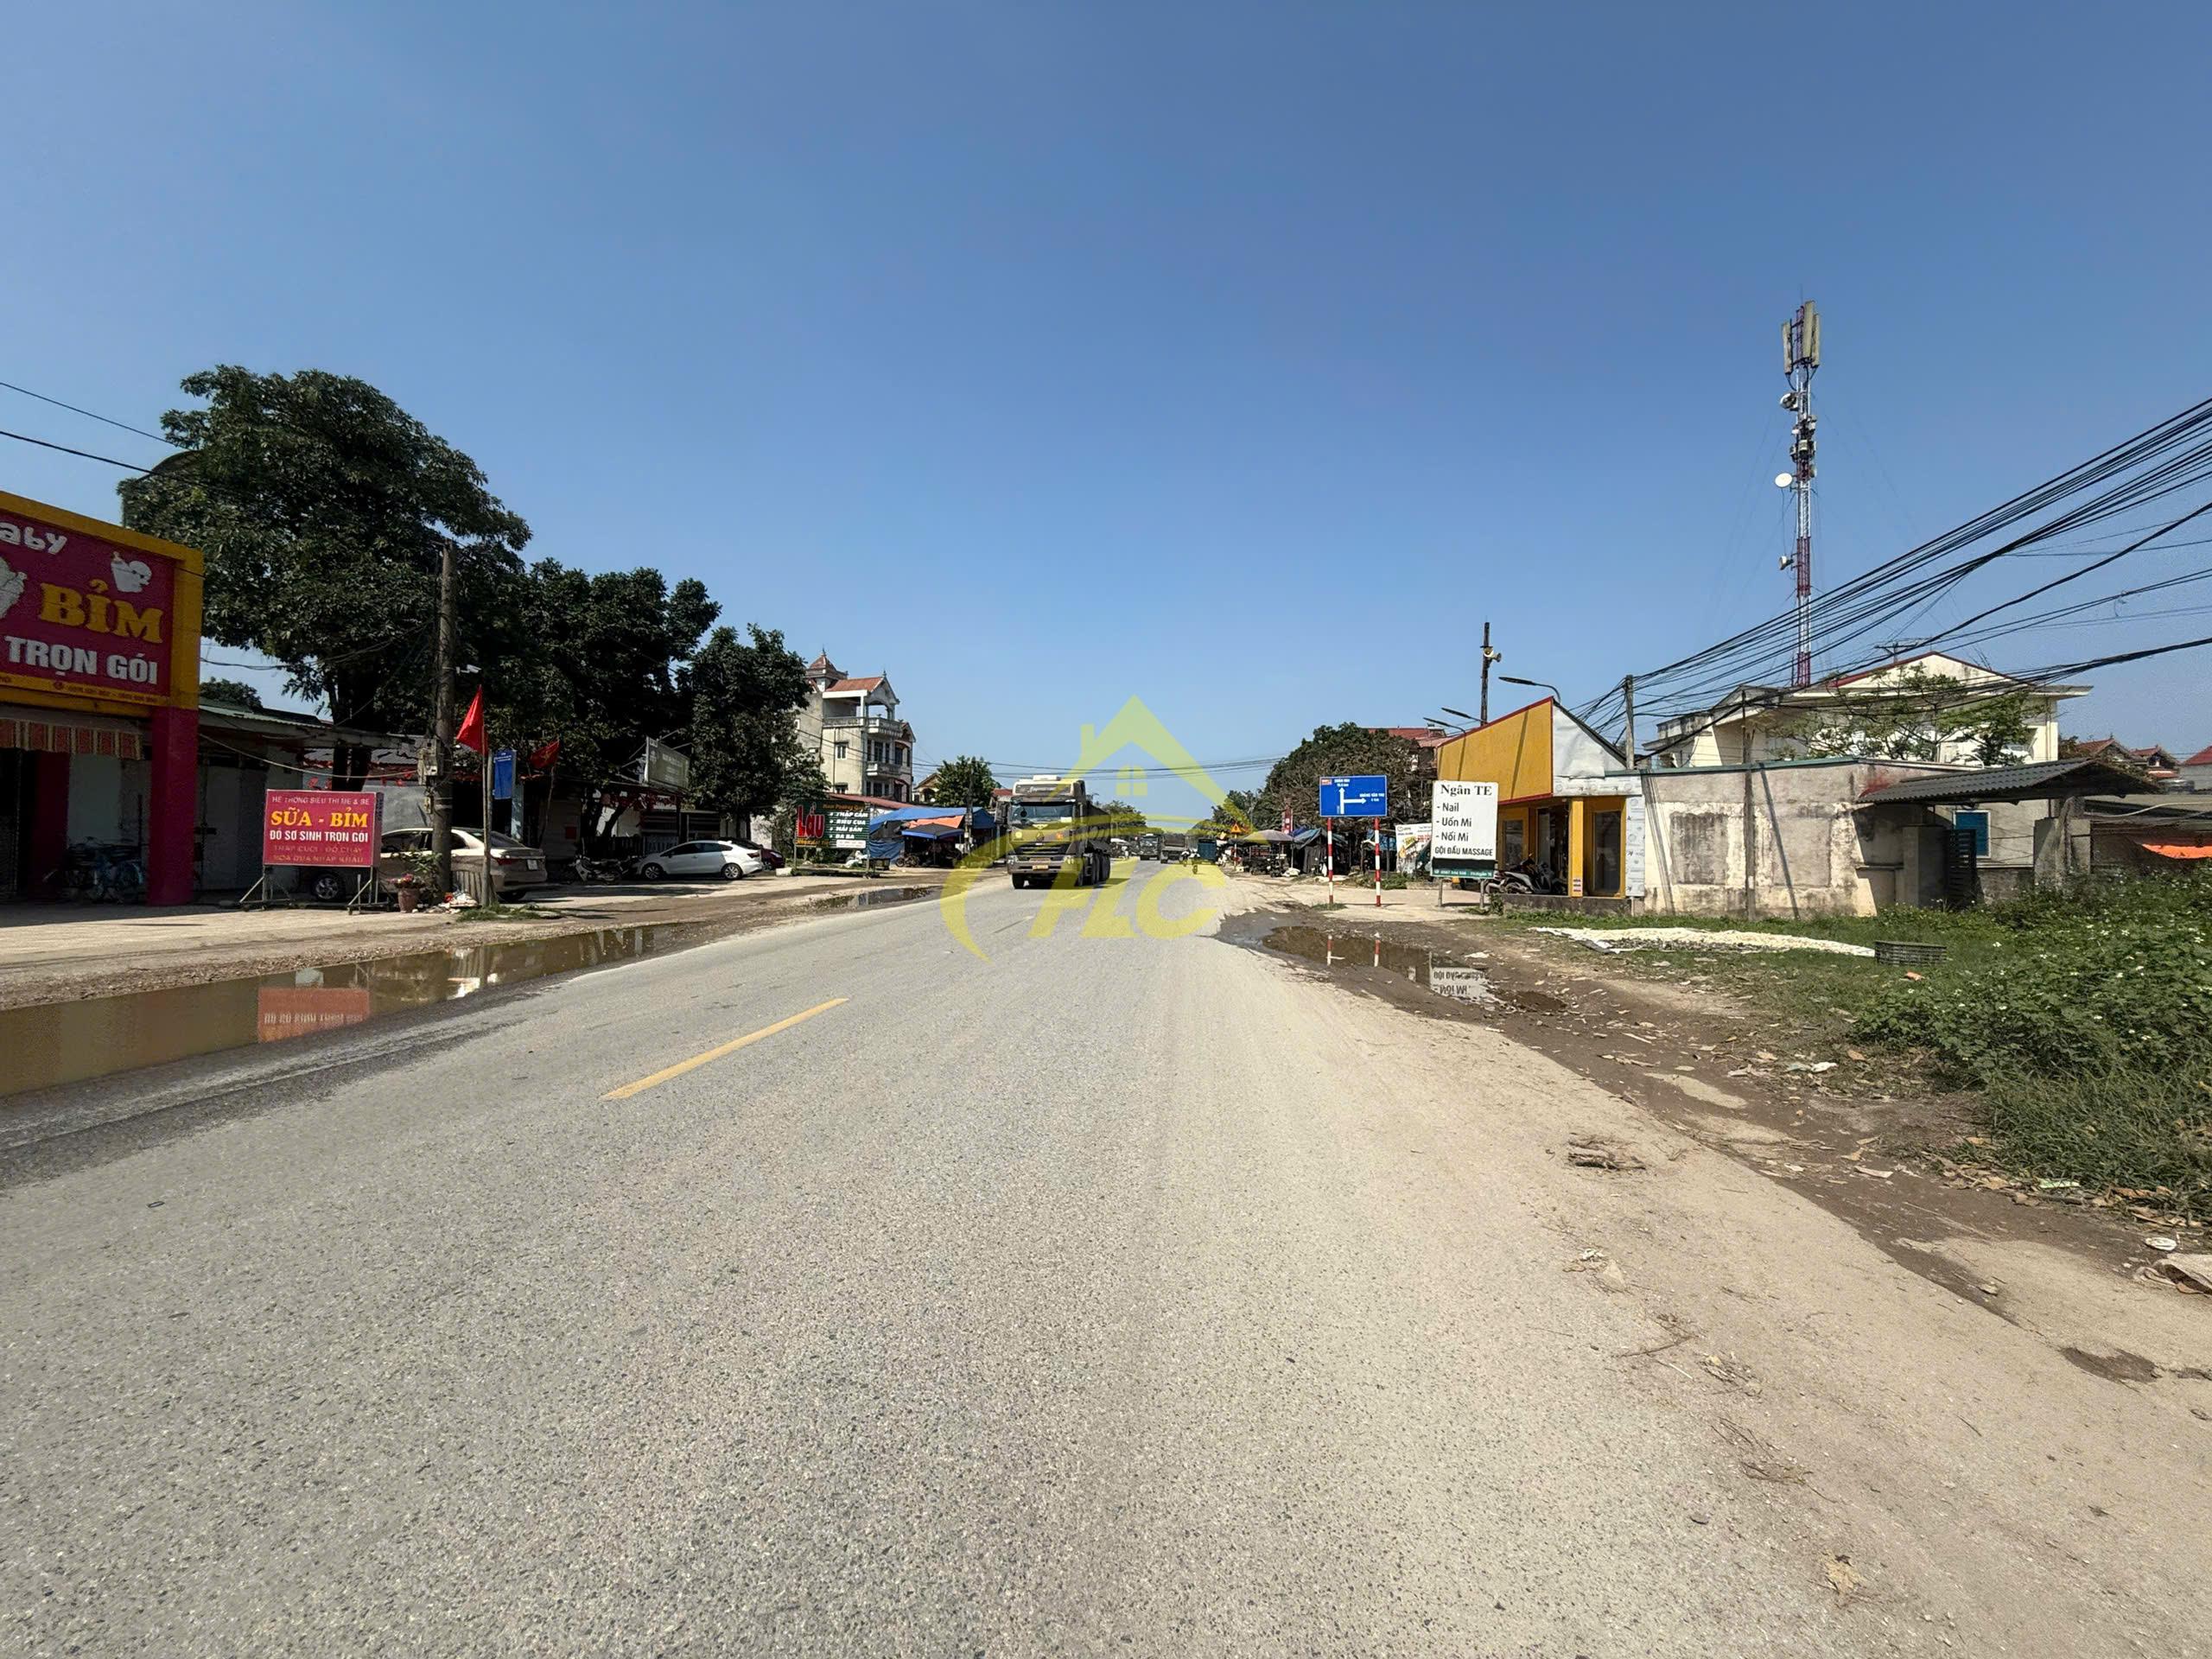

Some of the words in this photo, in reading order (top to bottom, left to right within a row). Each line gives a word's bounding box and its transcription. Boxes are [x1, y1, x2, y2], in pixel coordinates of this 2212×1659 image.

[39, 578, 164, 644] BỈM
[3, 635, 99, 677] TRỌN
[106, 652, 159, 684] GÓI
[1440, 784, 1471, 797] Ngân
[1474, 785, 1492, 795] TE
[1442, 803, 1459, 812] Nail
[270, 807, 312, 826] SỮA
[329, 806, 368, 828] BỈM
[797, 801, 825, 838] Lẩu
[1441, 817, 1459, 827] Uốn
[1460, 817, 1472, 827] Mi
[300, 831, 321, 842] SINH
[1441, 831, 1456, 842] Nối
[1458, 832, 1469, 842] Mi
[1462, 848, 1493, 856] MASSAGE
